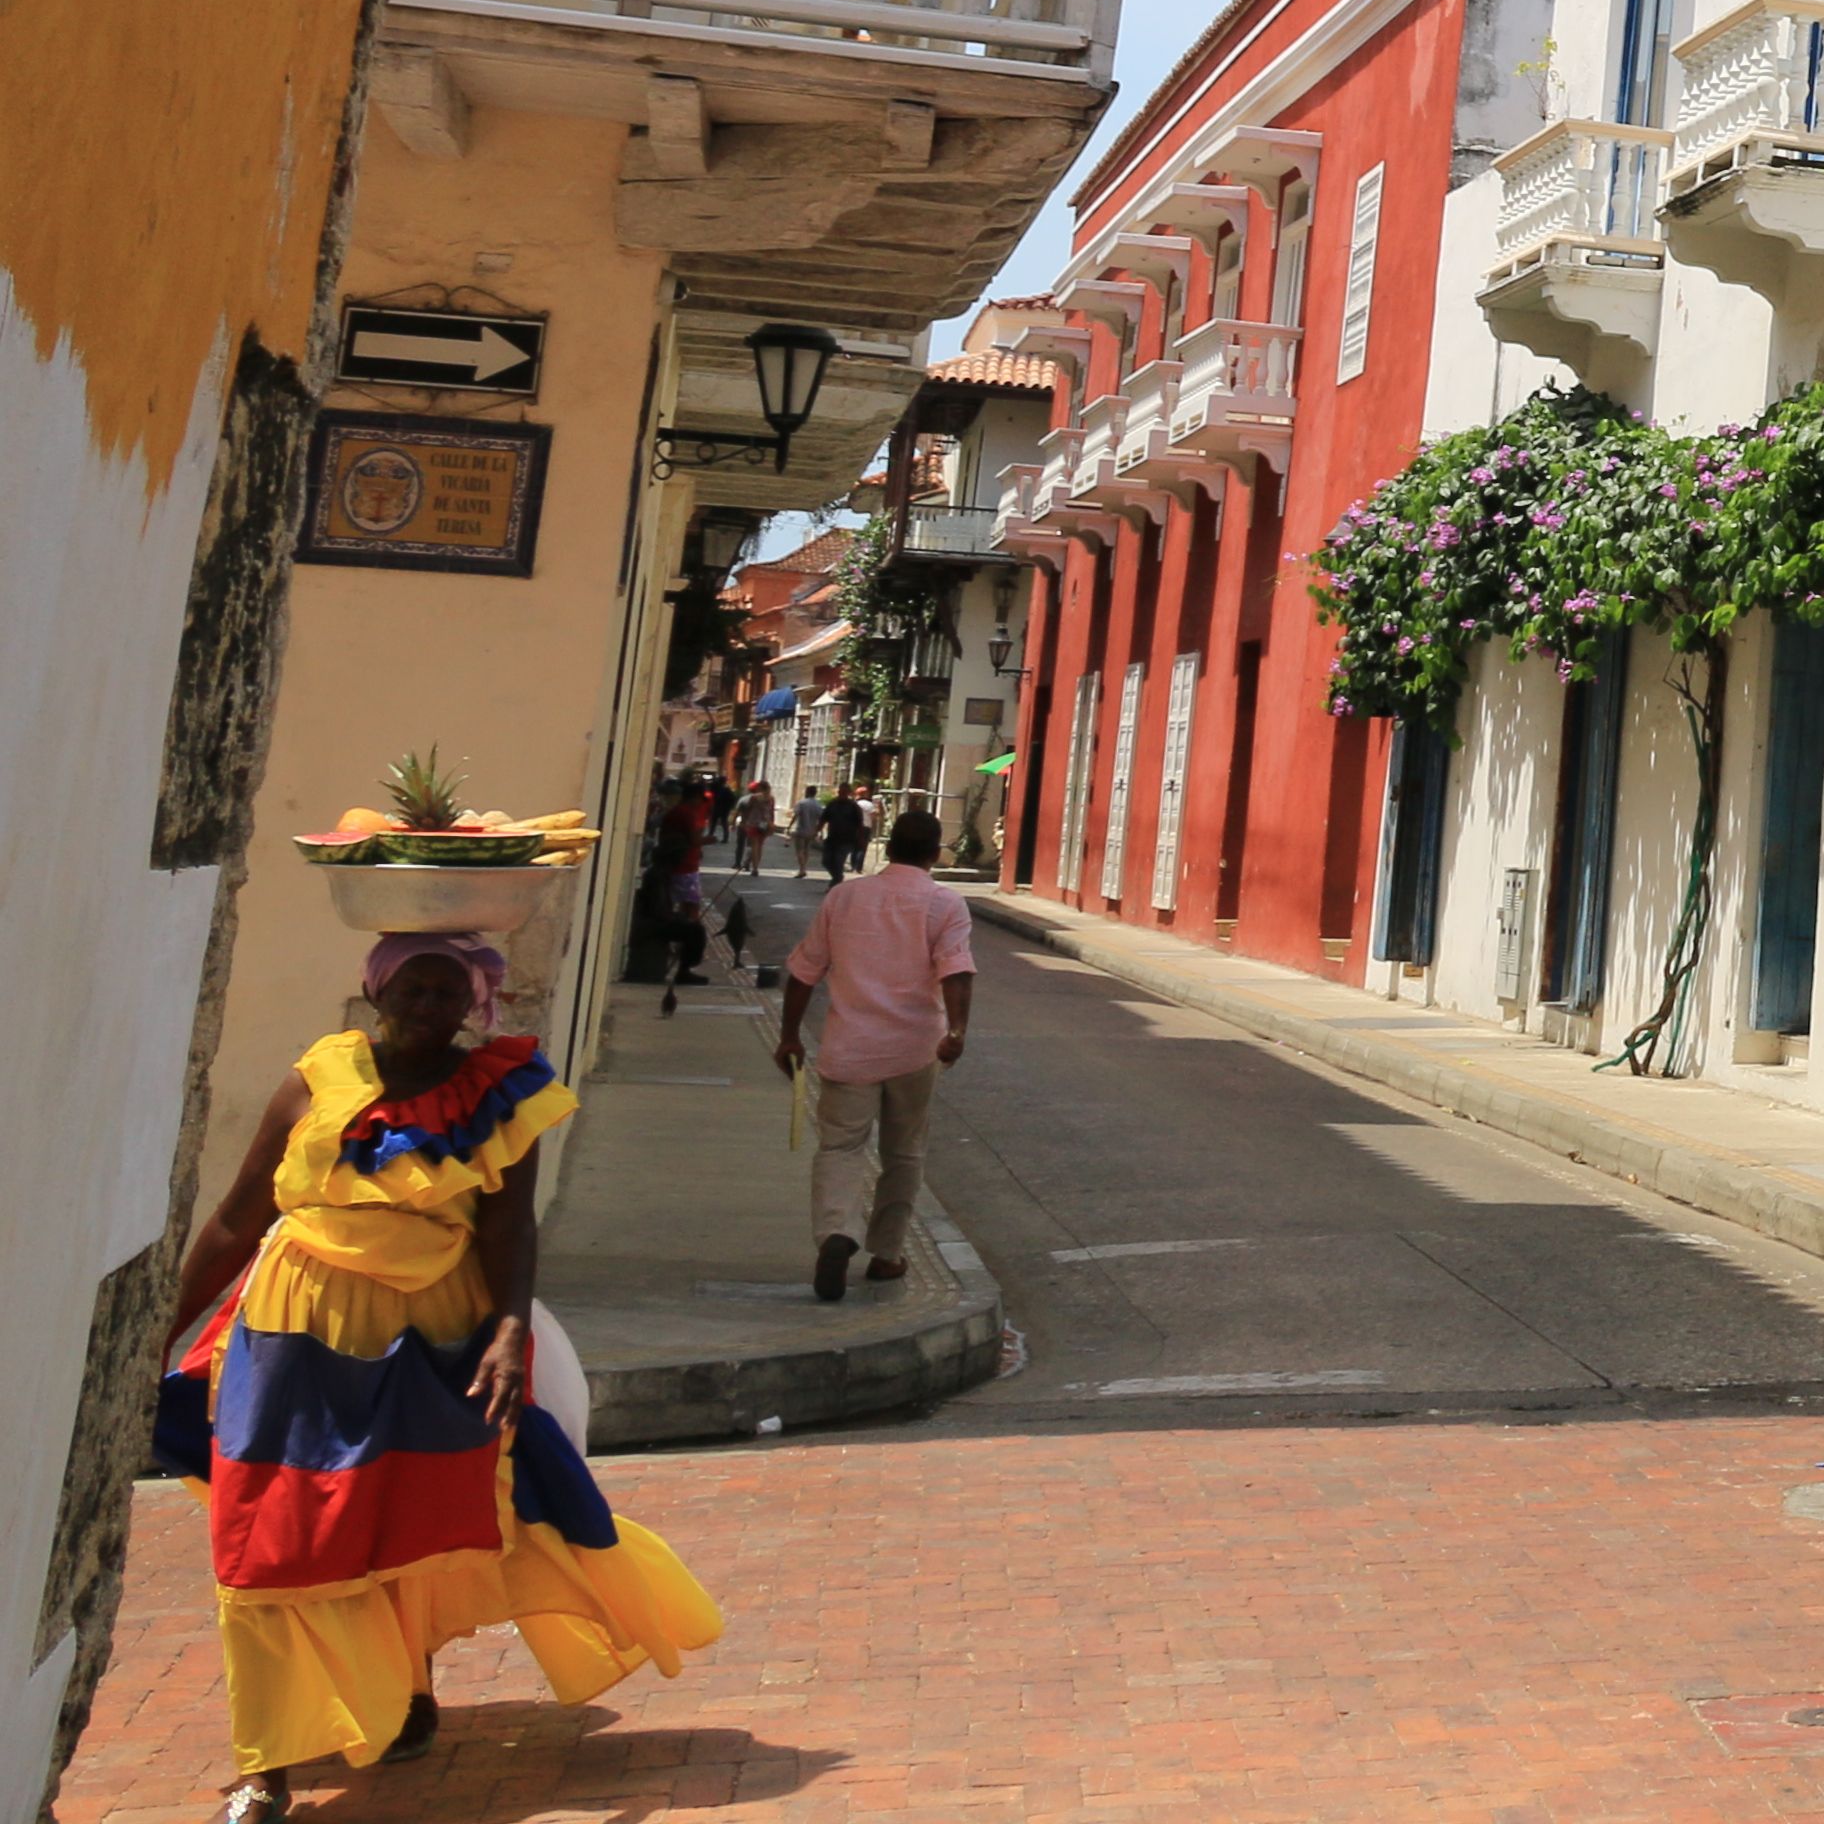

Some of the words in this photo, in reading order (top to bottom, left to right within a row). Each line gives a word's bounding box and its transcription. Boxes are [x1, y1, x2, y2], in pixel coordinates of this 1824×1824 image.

[431, 453, 468, 469] CALLE
[472, 455, 486, 470] DE
[491, 457, 507, 472] LA
[433, 495, 448, 512] DE
[455, 497, 490, 514] SANTA
[437, 518, 482, 535] TERESA
